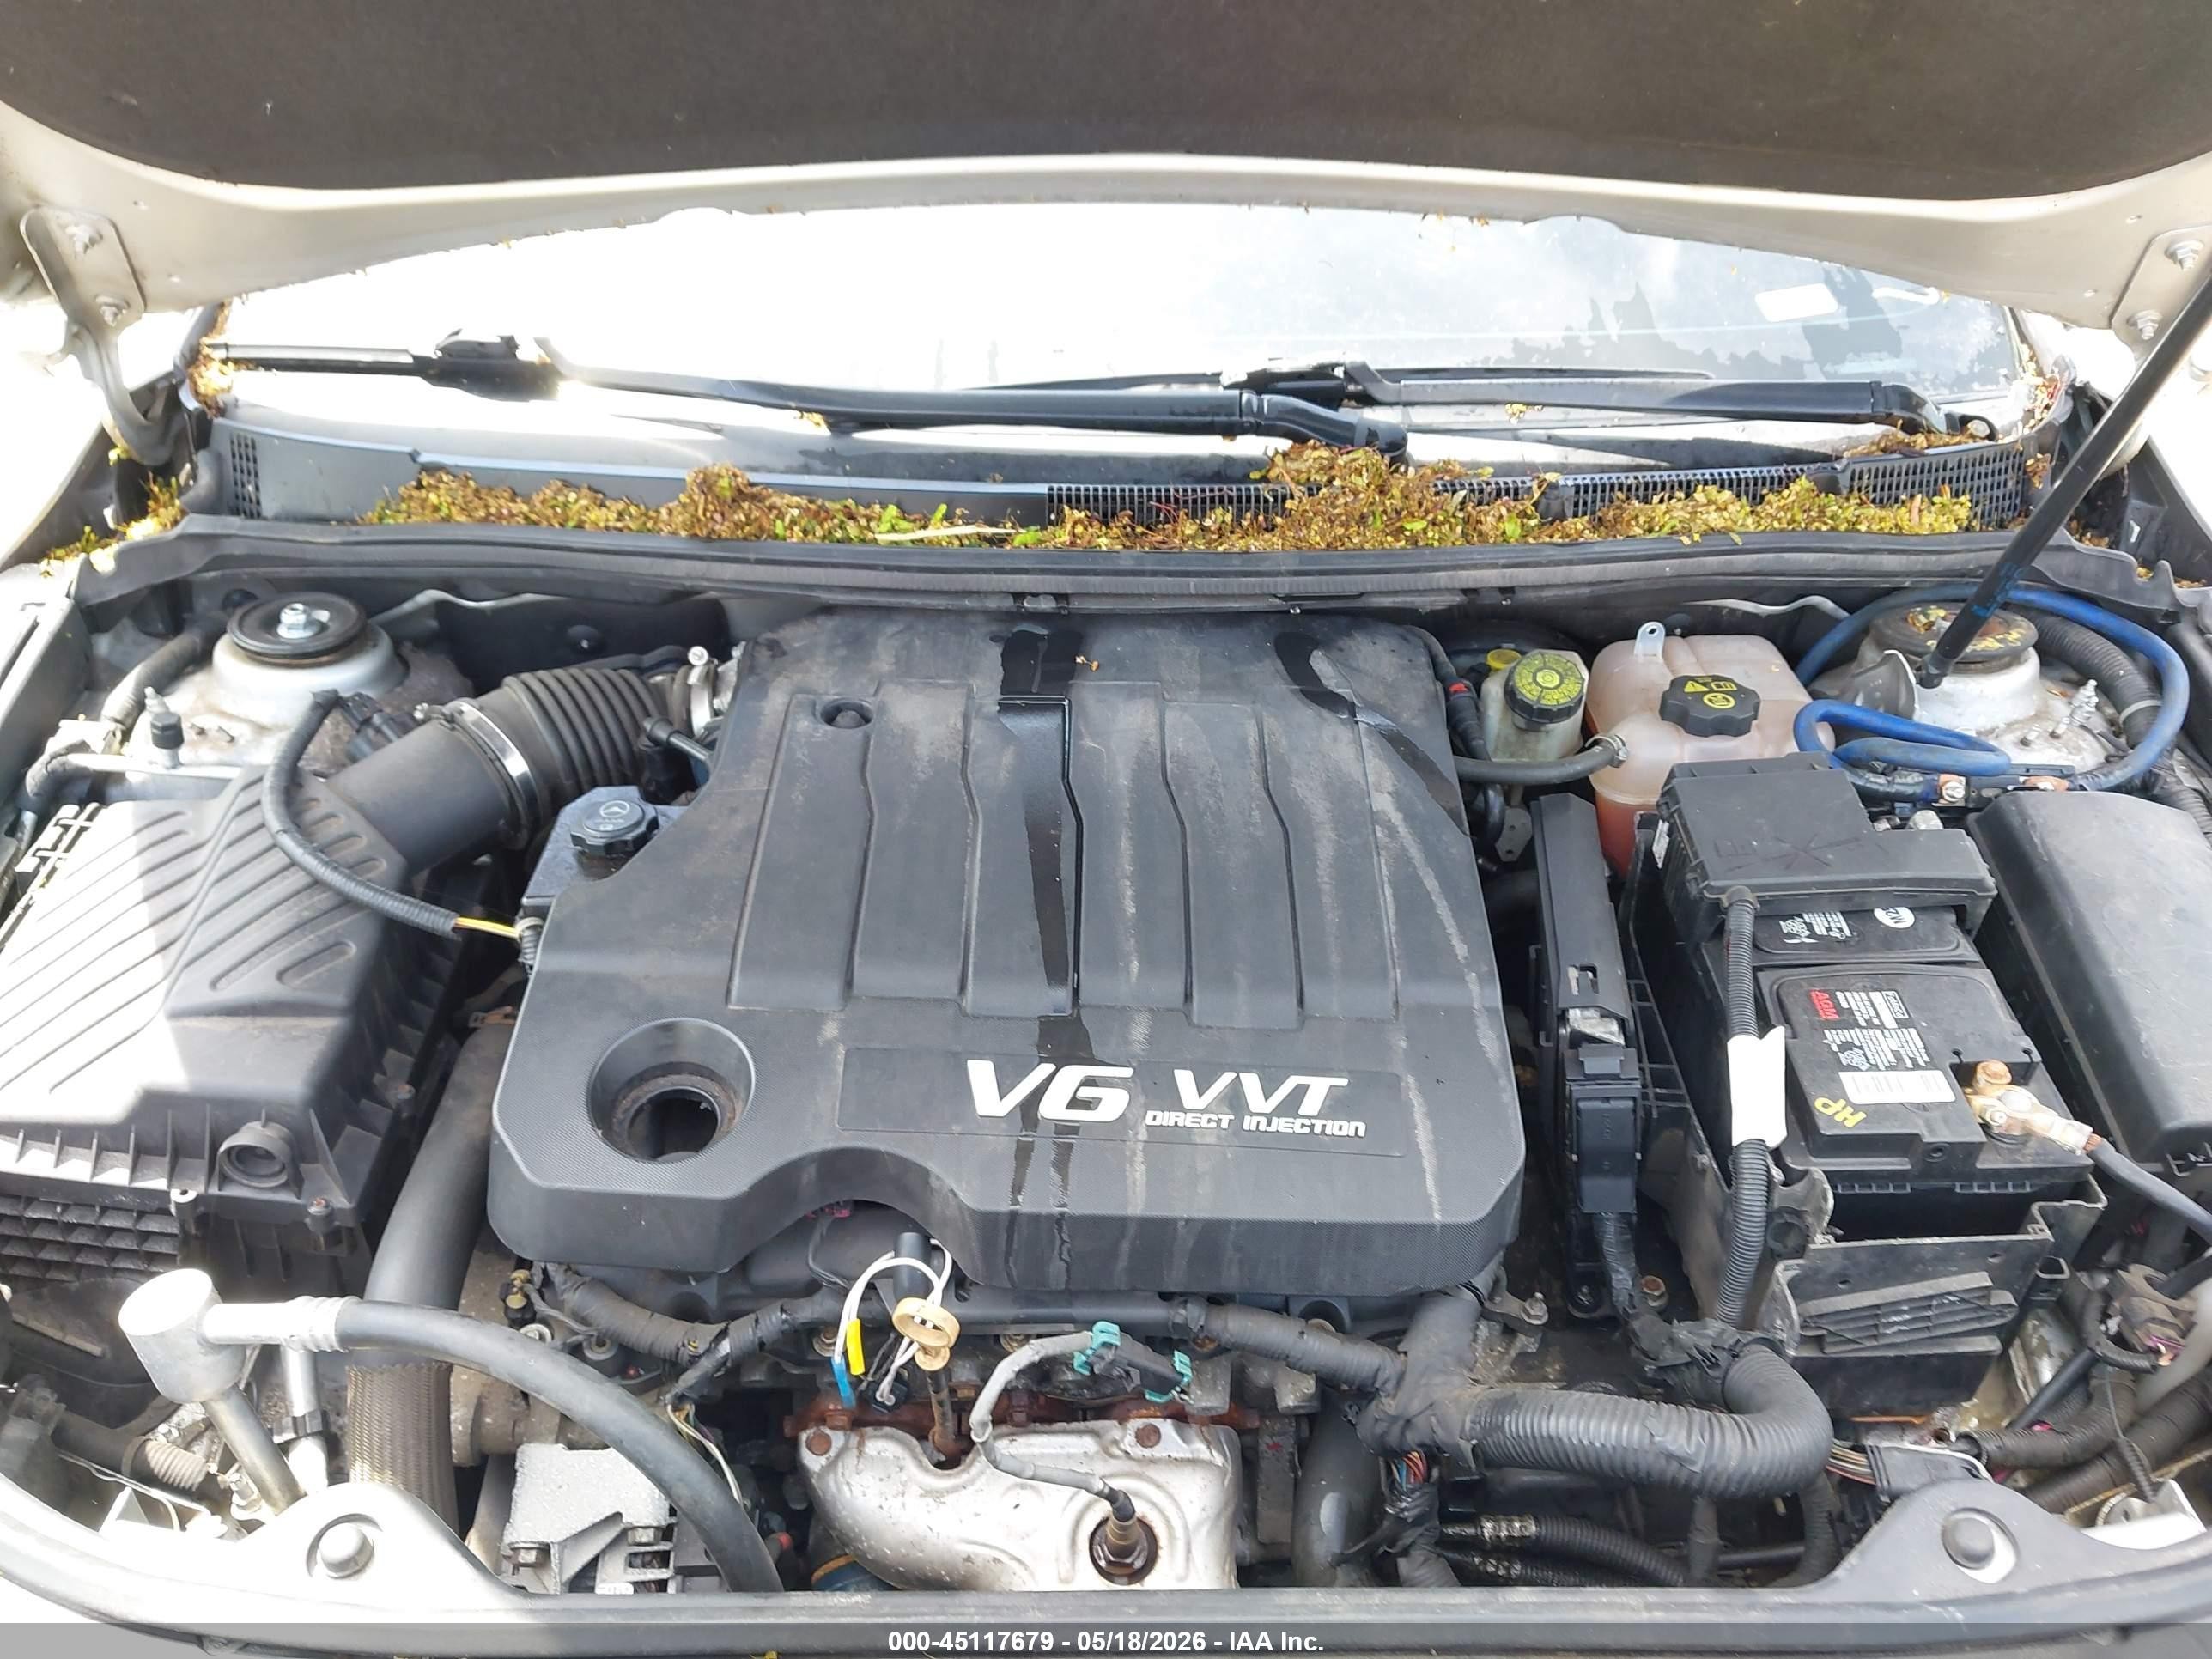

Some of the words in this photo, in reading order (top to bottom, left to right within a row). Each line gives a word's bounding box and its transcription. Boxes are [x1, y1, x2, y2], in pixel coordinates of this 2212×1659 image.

[1811, 990, 1840, 1019] AGM
[966, 1059, 1134, 1122] V6
[1173, 1069, 1349, 1116] VVT
[1145, 1109, 1235, 1130] DIRECT
[1242, 1114, 1366, 1138] INJECTION
[1814, 1097, 1868, 1127] HP
